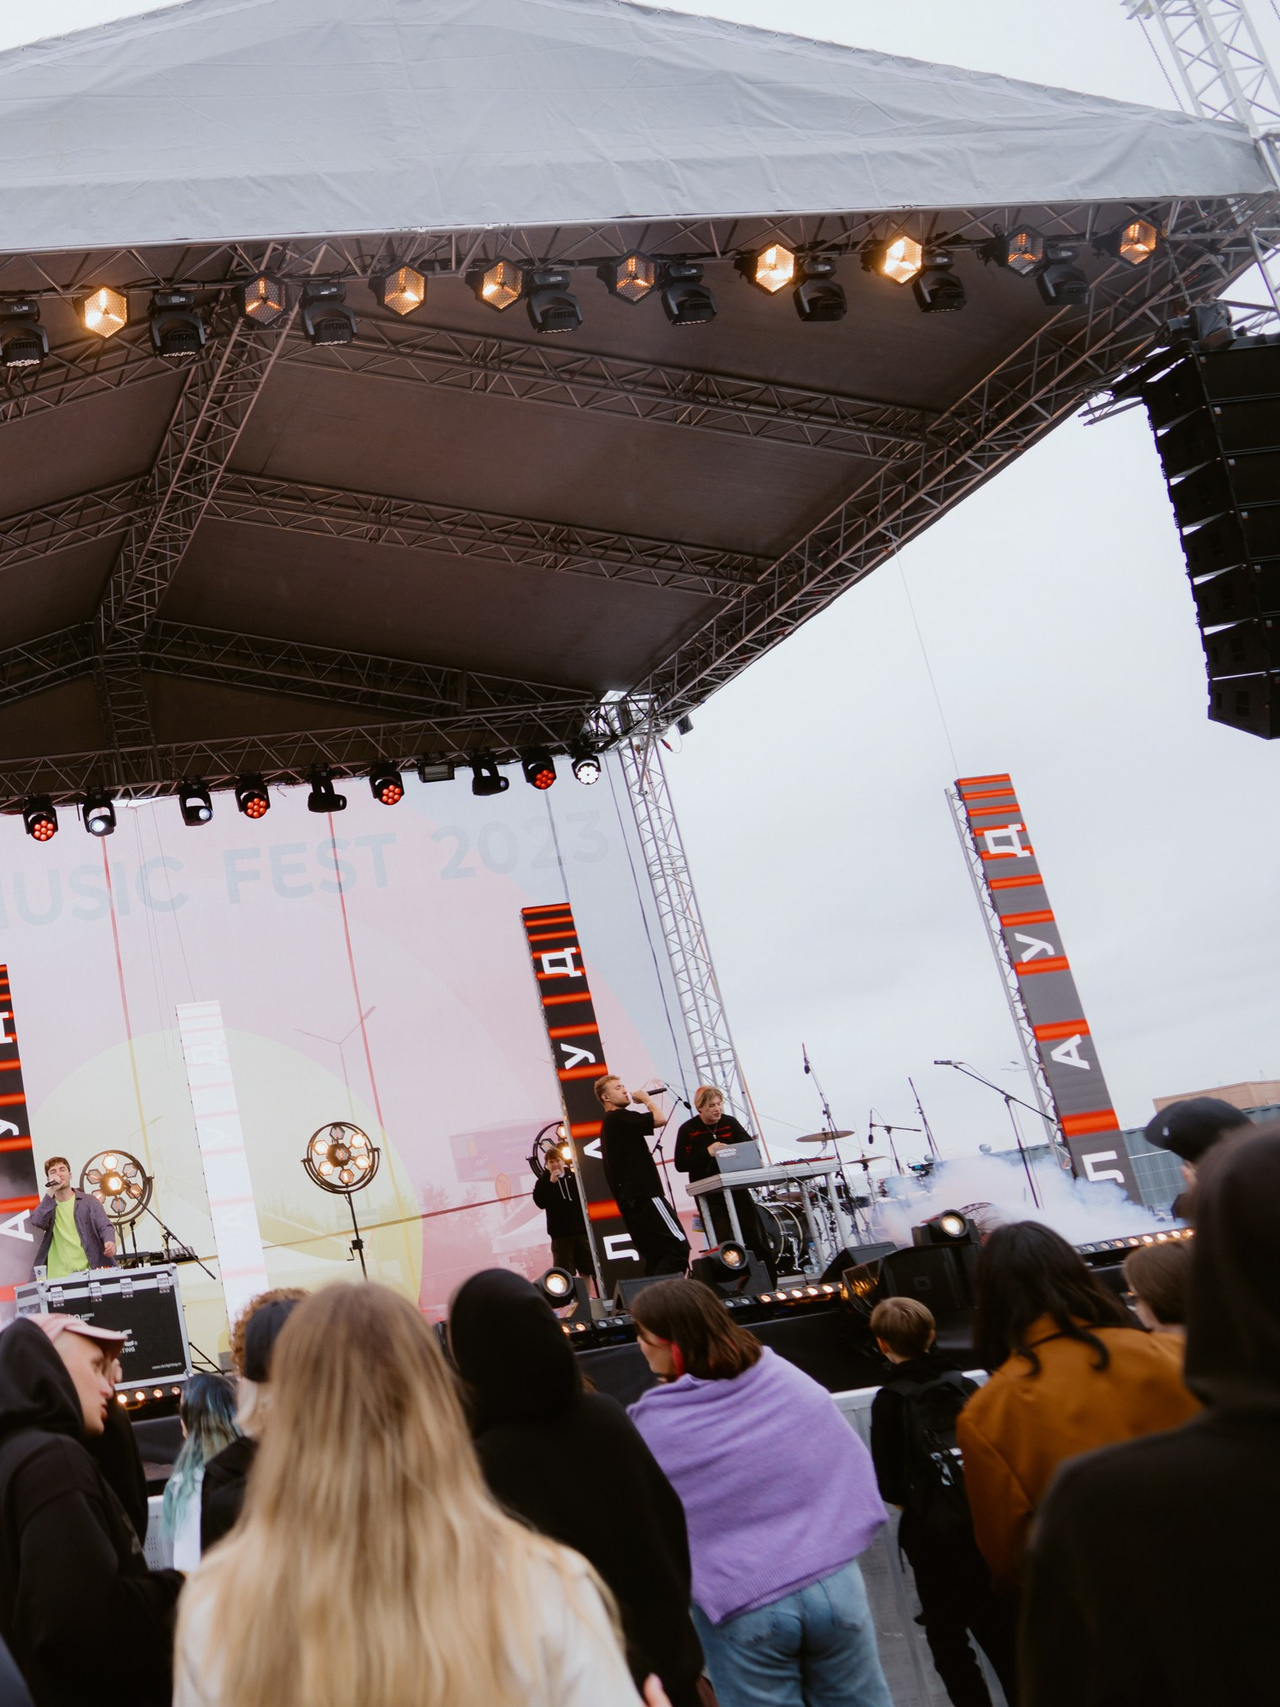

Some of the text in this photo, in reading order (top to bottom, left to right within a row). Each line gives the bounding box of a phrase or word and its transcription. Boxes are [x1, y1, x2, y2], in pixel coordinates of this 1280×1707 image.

[224, 831, 398, 905] FEST
[438, 810, 611, 883] 2023
[983, 823, 1125, 1184] ЛАУД
